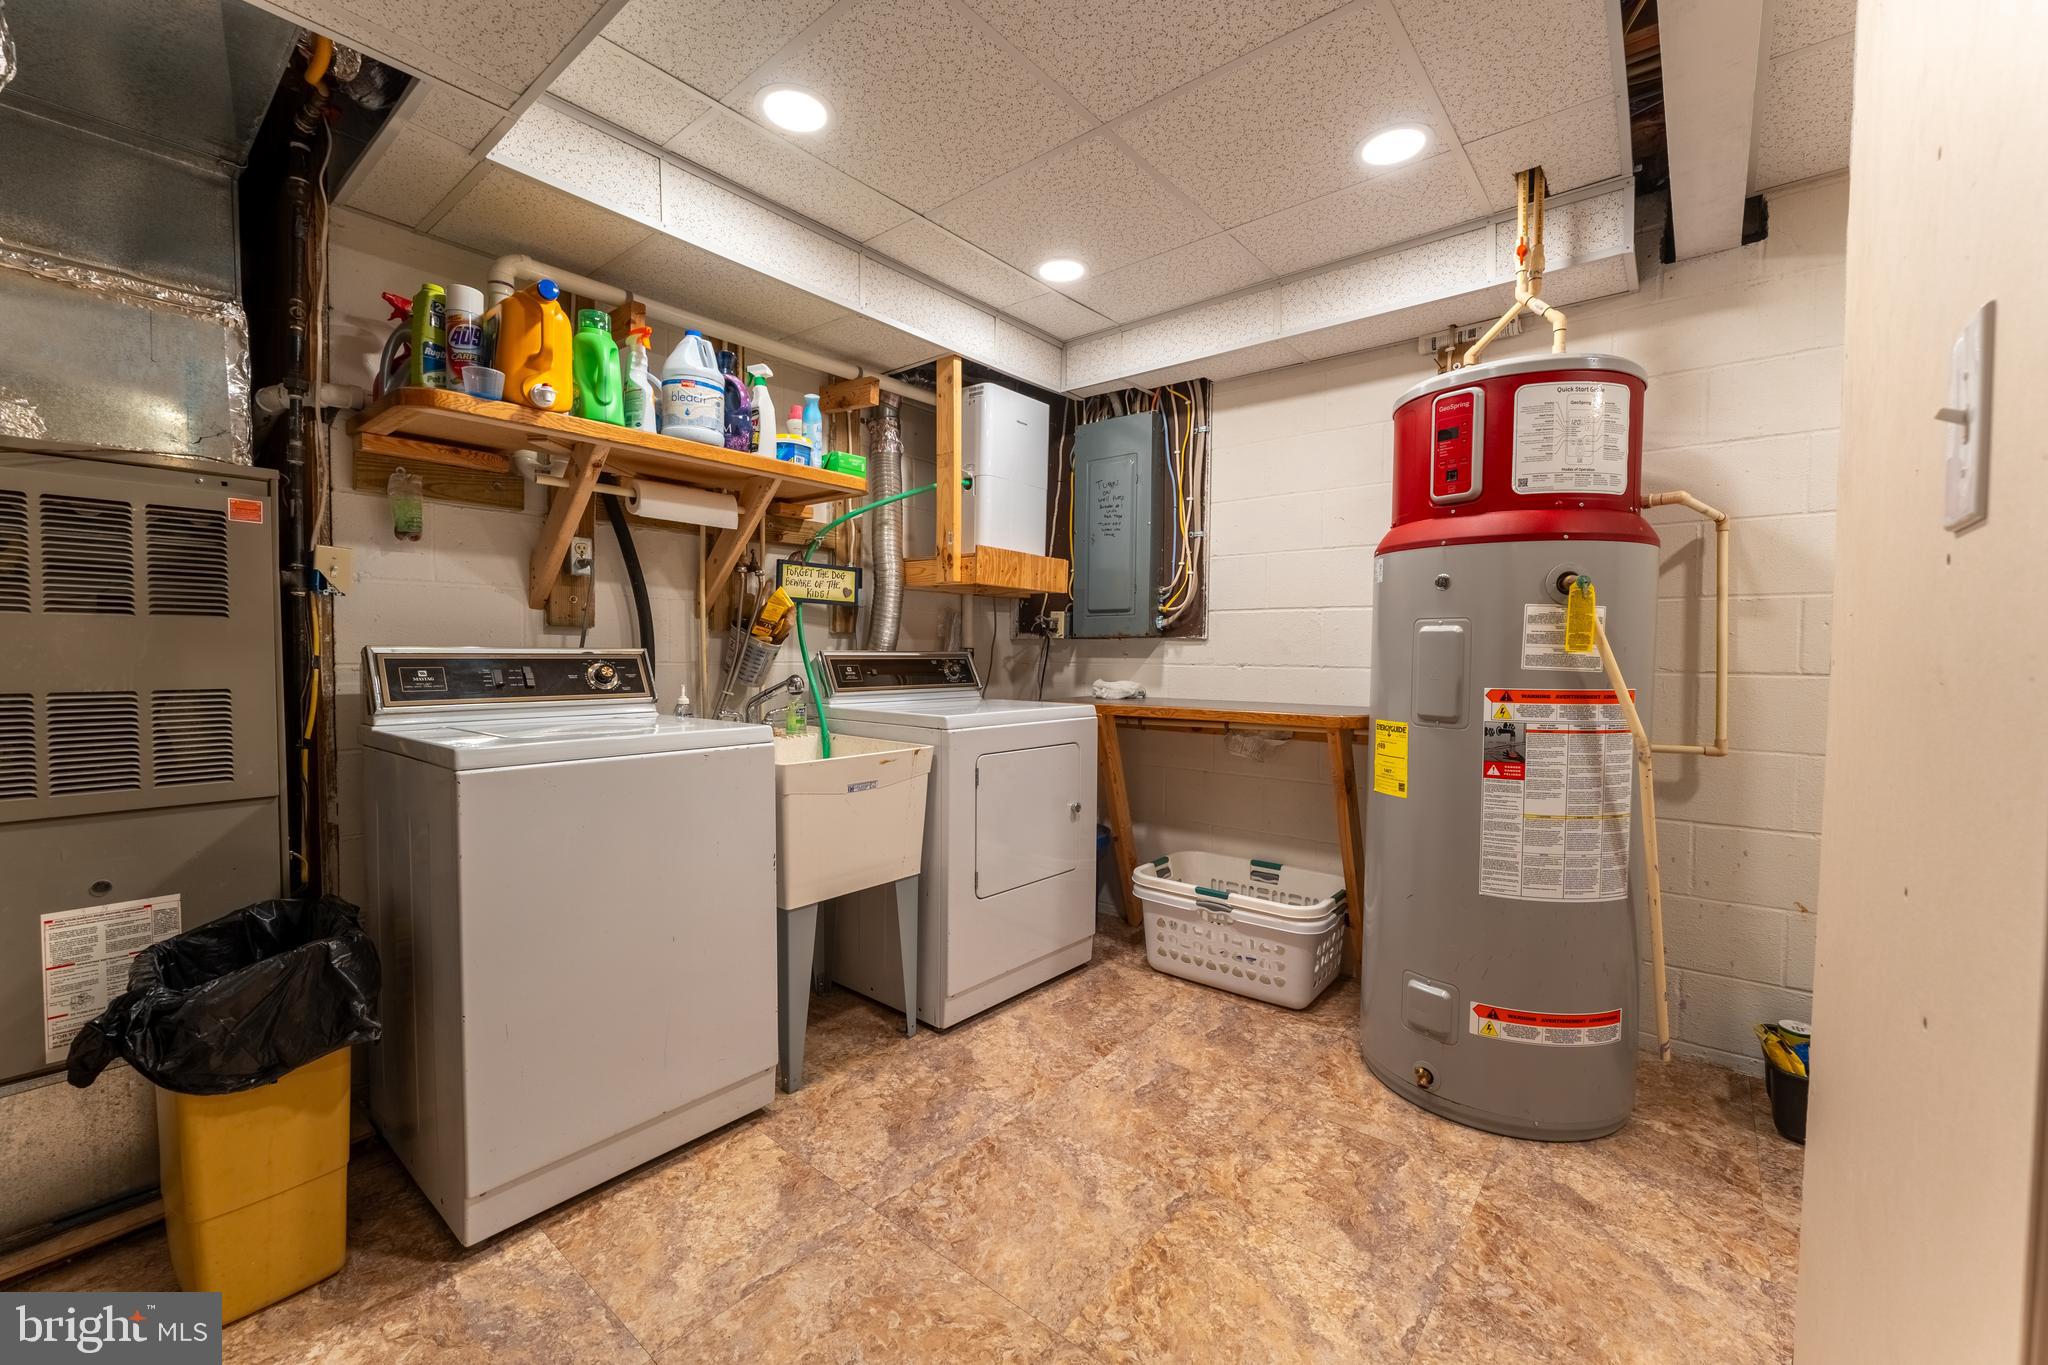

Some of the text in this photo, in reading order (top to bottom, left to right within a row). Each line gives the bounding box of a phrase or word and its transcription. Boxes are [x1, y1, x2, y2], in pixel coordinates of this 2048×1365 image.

[451, 325, 482, 347] 409
[451, 351, 479, 361] CARP
[1438, 401, 1470, 413] GeoSpring
[786, 565, 846, 580] FORGET THE DOG
[785, 577, 841, 589] BEWARE OF THE
[52, 1032, 67, 1041] FOR
